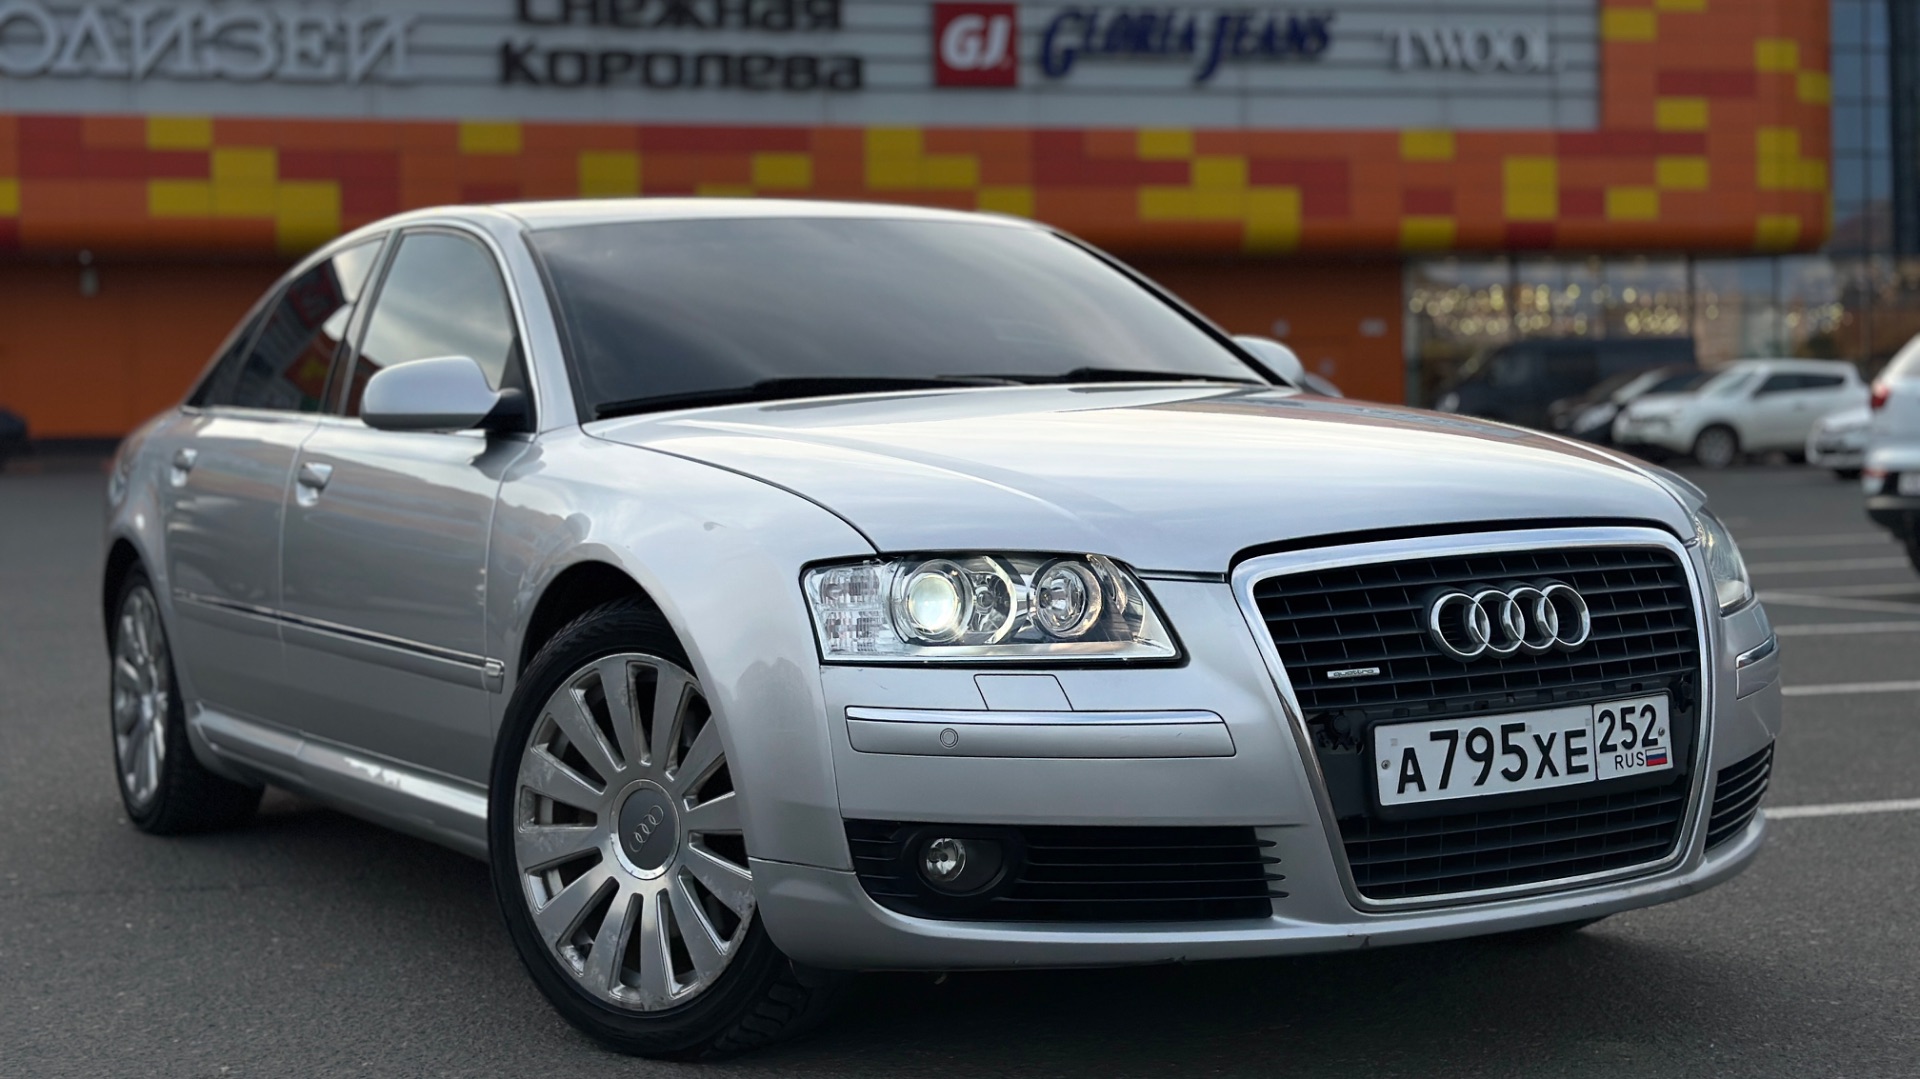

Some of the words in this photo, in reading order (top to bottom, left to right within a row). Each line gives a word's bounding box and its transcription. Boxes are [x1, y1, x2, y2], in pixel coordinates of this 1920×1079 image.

[499, 39, 864, 92] Королева
[940, 13, 1012, 71] GJ
[1597, 703, 1659, 754] 252
[1614, 750, 1645, 771] RUS
